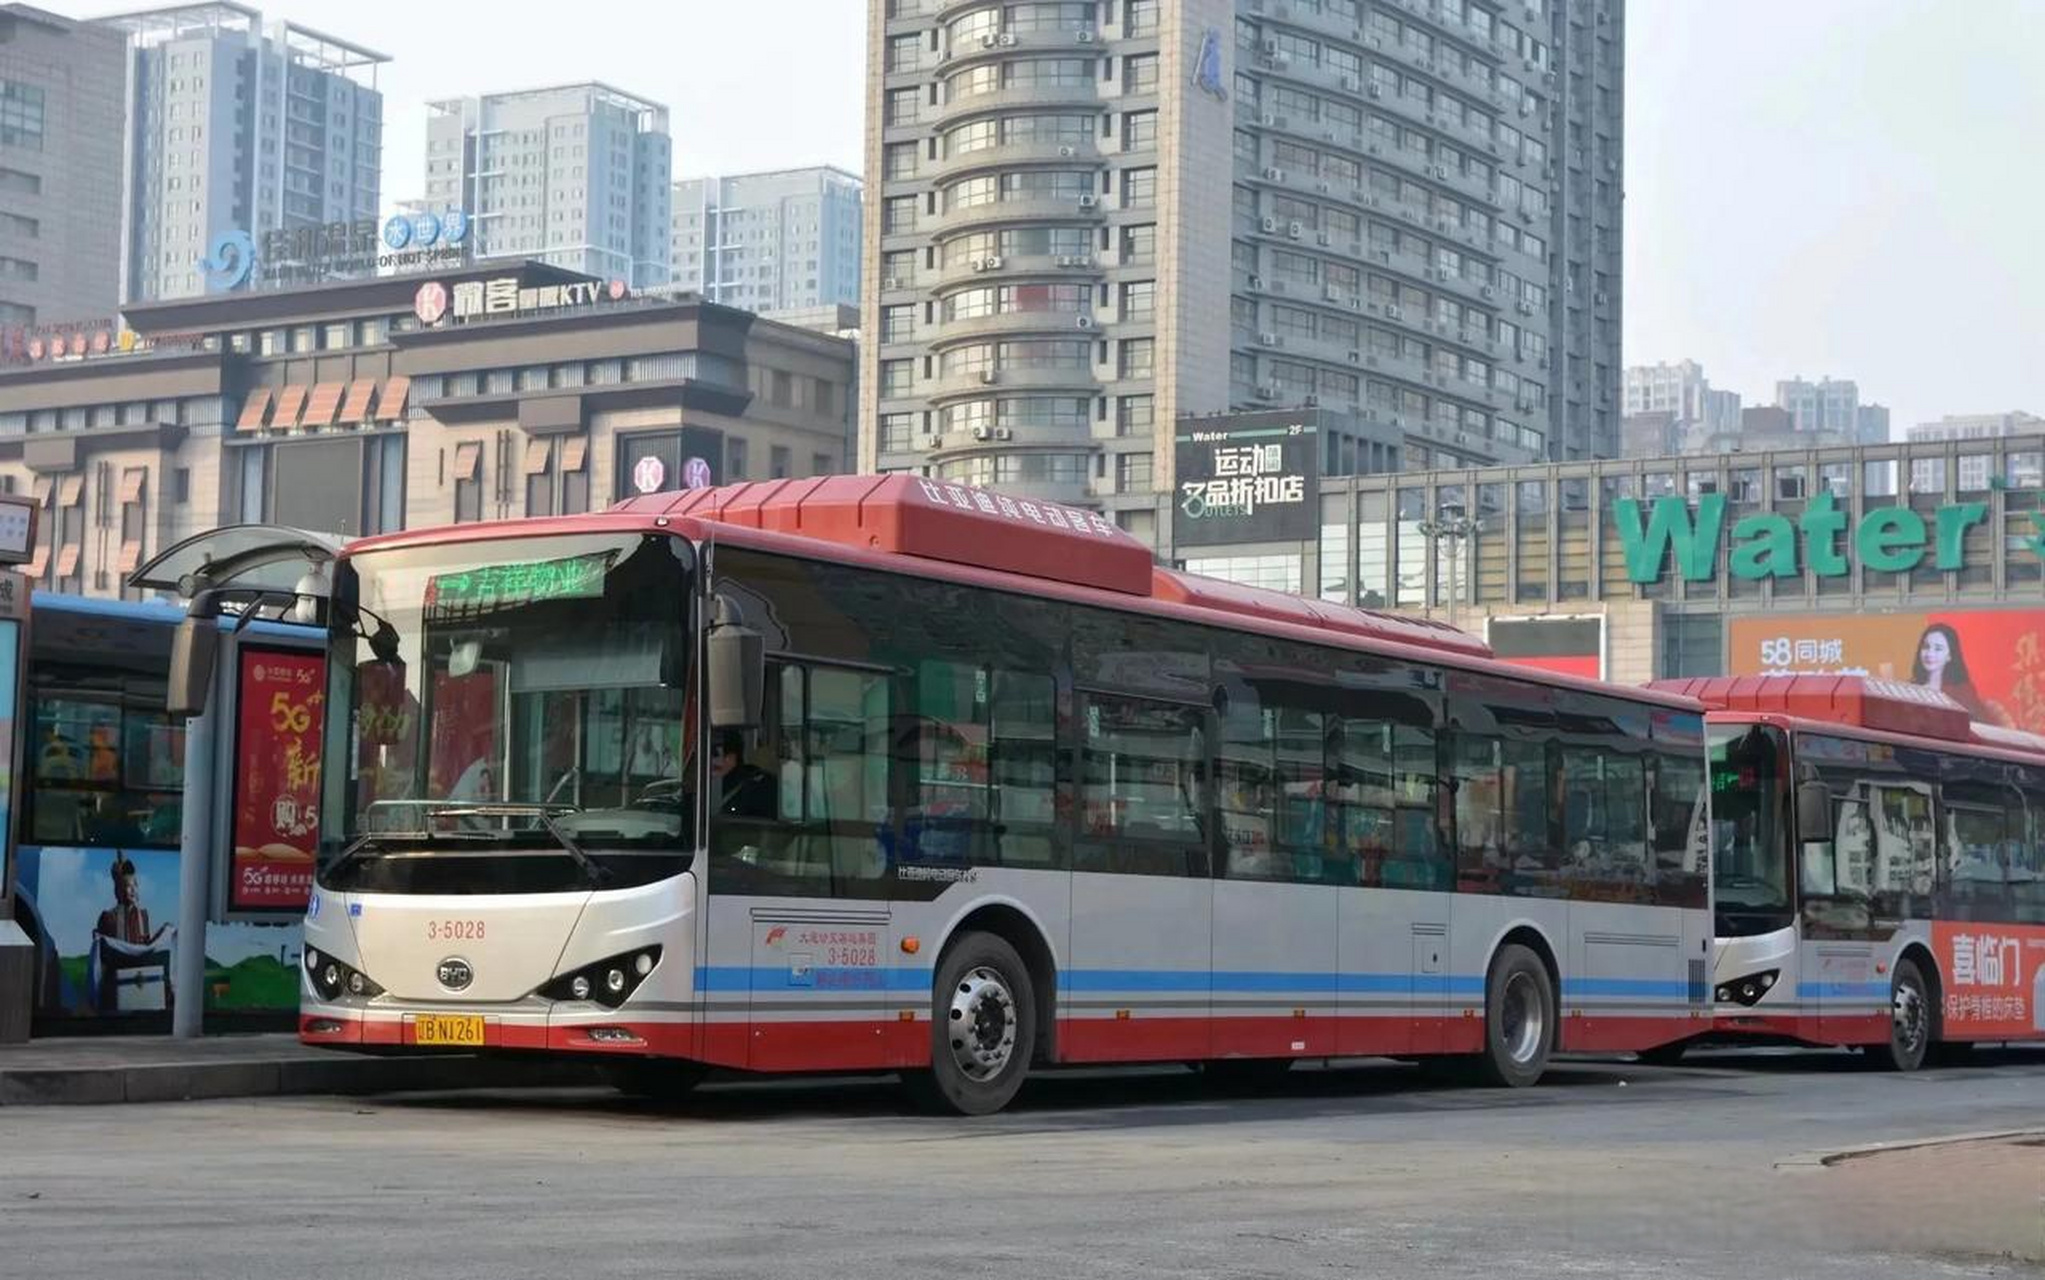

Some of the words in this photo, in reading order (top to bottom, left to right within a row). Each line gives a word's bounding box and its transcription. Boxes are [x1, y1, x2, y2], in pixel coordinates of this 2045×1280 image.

[387, 210, 463, 245] 水世界
[1192, 431, 1229, 443] Water
[1288, 425, 1303, 436] 2F
[1214, 444, 1265, 477] 运动
[919, 479, 1113, 537] 比亚迪纯电动客车
[1181, 475, 1305, 515] 名品折扣店
[1613, 491, 1987, 584] Water
[1761, 637, 1844, 666] 58同城
[428, 920, 486, 940] 3-5028
[827, 947, 877, 967] 3-5028
[1952, 932, 2020, 987] 喜临门
[439, 966, 469, 982] BYD
